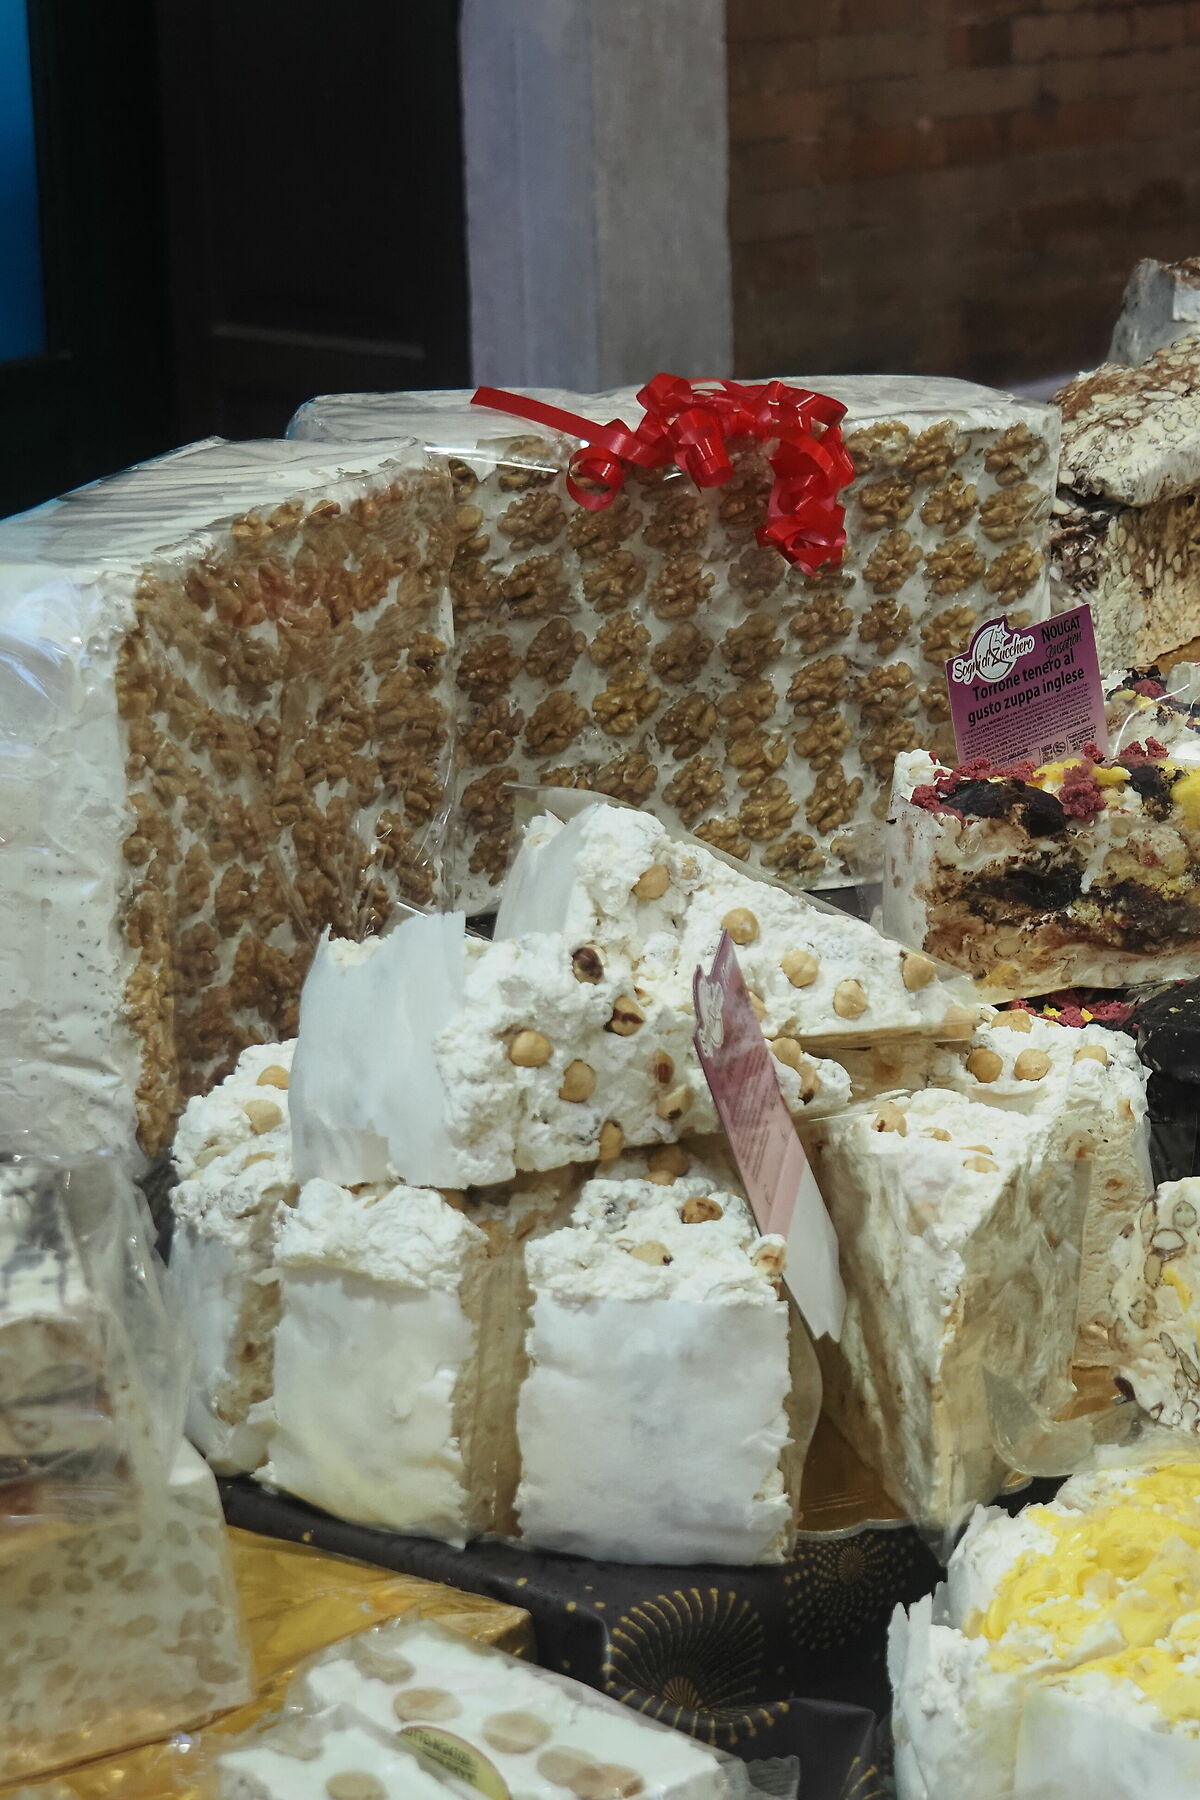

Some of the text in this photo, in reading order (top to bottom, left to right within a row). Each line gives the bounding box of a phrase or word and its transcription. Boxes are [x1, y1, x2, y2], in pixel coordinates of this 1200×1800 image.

[1041, 615, 1081, 644] NOUGAT
[990, 635, 1034, 668] Zucchero
[972, 649, 1076, 702] Torrone tenero al
[968, 668, 1085, 727] gusto zuppa inglese
